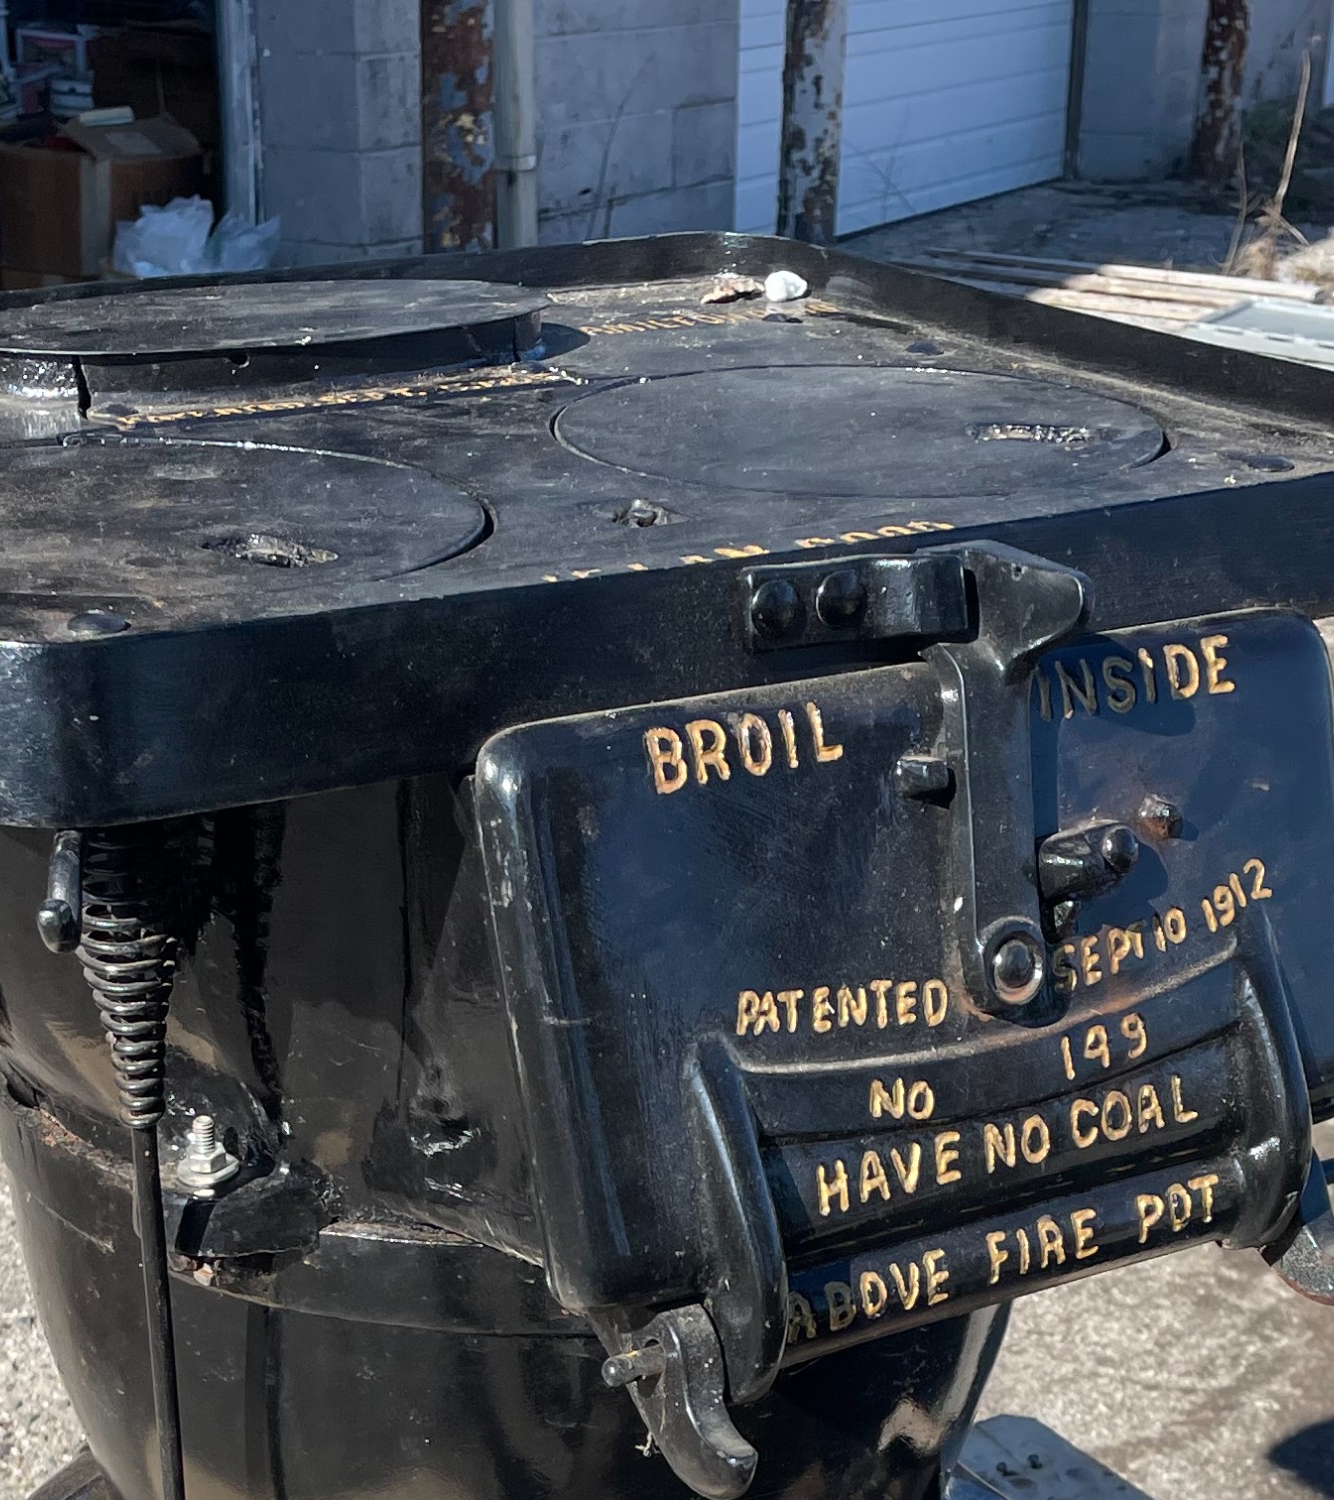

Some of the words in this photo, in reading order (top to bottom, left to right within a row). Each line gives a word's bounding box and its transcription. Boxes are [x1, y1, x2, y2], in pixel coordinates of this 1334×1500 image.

[644, 702, 843, 794] BROIL
[1035, 634, 1235, 722] INSIDE
[736, 979, 948, 1036] PATENTED
[1053, 920, 1147, 992] SEPT
[1153, 905, 1187, 953] 10
[1202, 857, 1273, 933] 1912
[816, 1131, 963, 1217] HAVE
[984, 1115, 1051, 1174] NO
[1070, 1075, 1198, 1149] COAL
[869, 1077, 935, 1120] NO
[786, 1247, 951, 1344] ABOVE
[985, 1208, 1100, 1285] FIRE
[1135, 1173, 1219, 1244] POT
